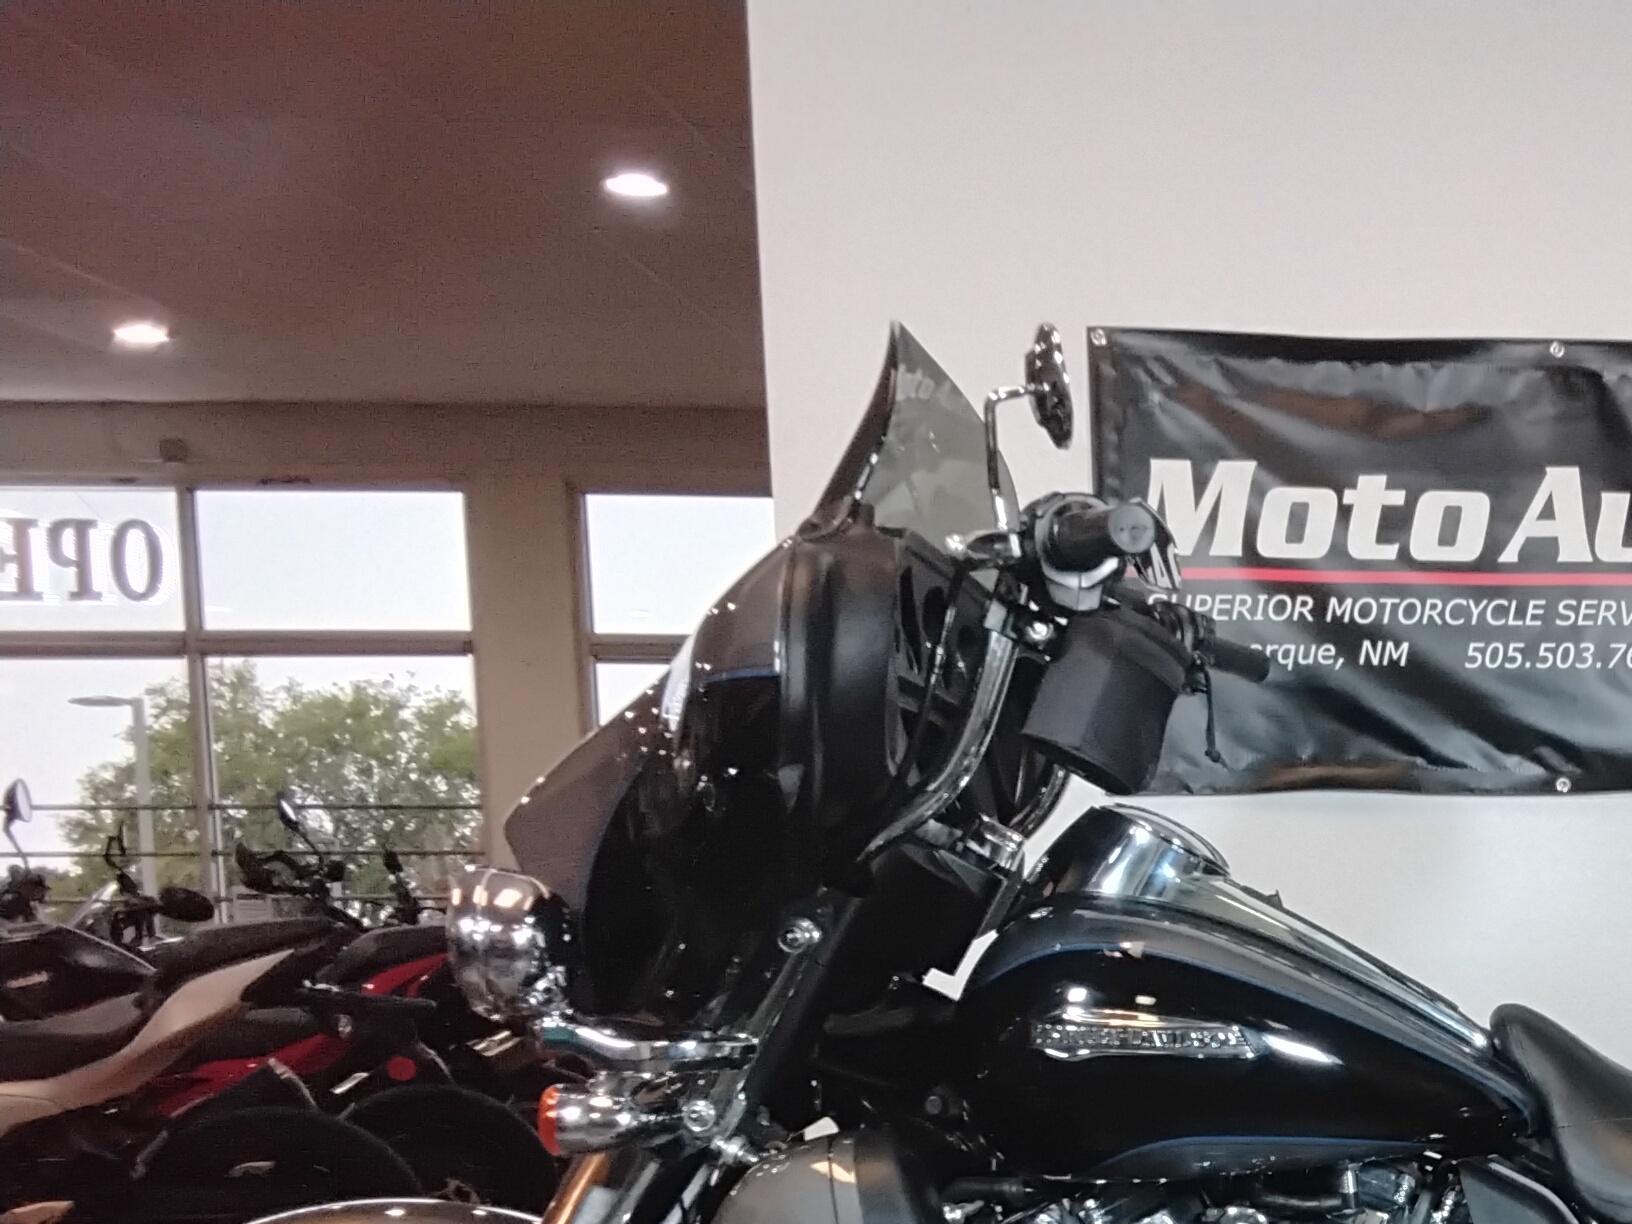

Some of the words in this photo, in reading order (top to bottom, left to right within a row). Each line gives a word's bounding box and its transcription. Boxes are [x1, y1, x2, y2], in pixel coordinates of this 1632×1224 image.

[1148, 458, 1491, 562] Moto
[1326, 596, 1547, 626] MOTORCYCLE
[1359, 640, 1409, 667] NM
